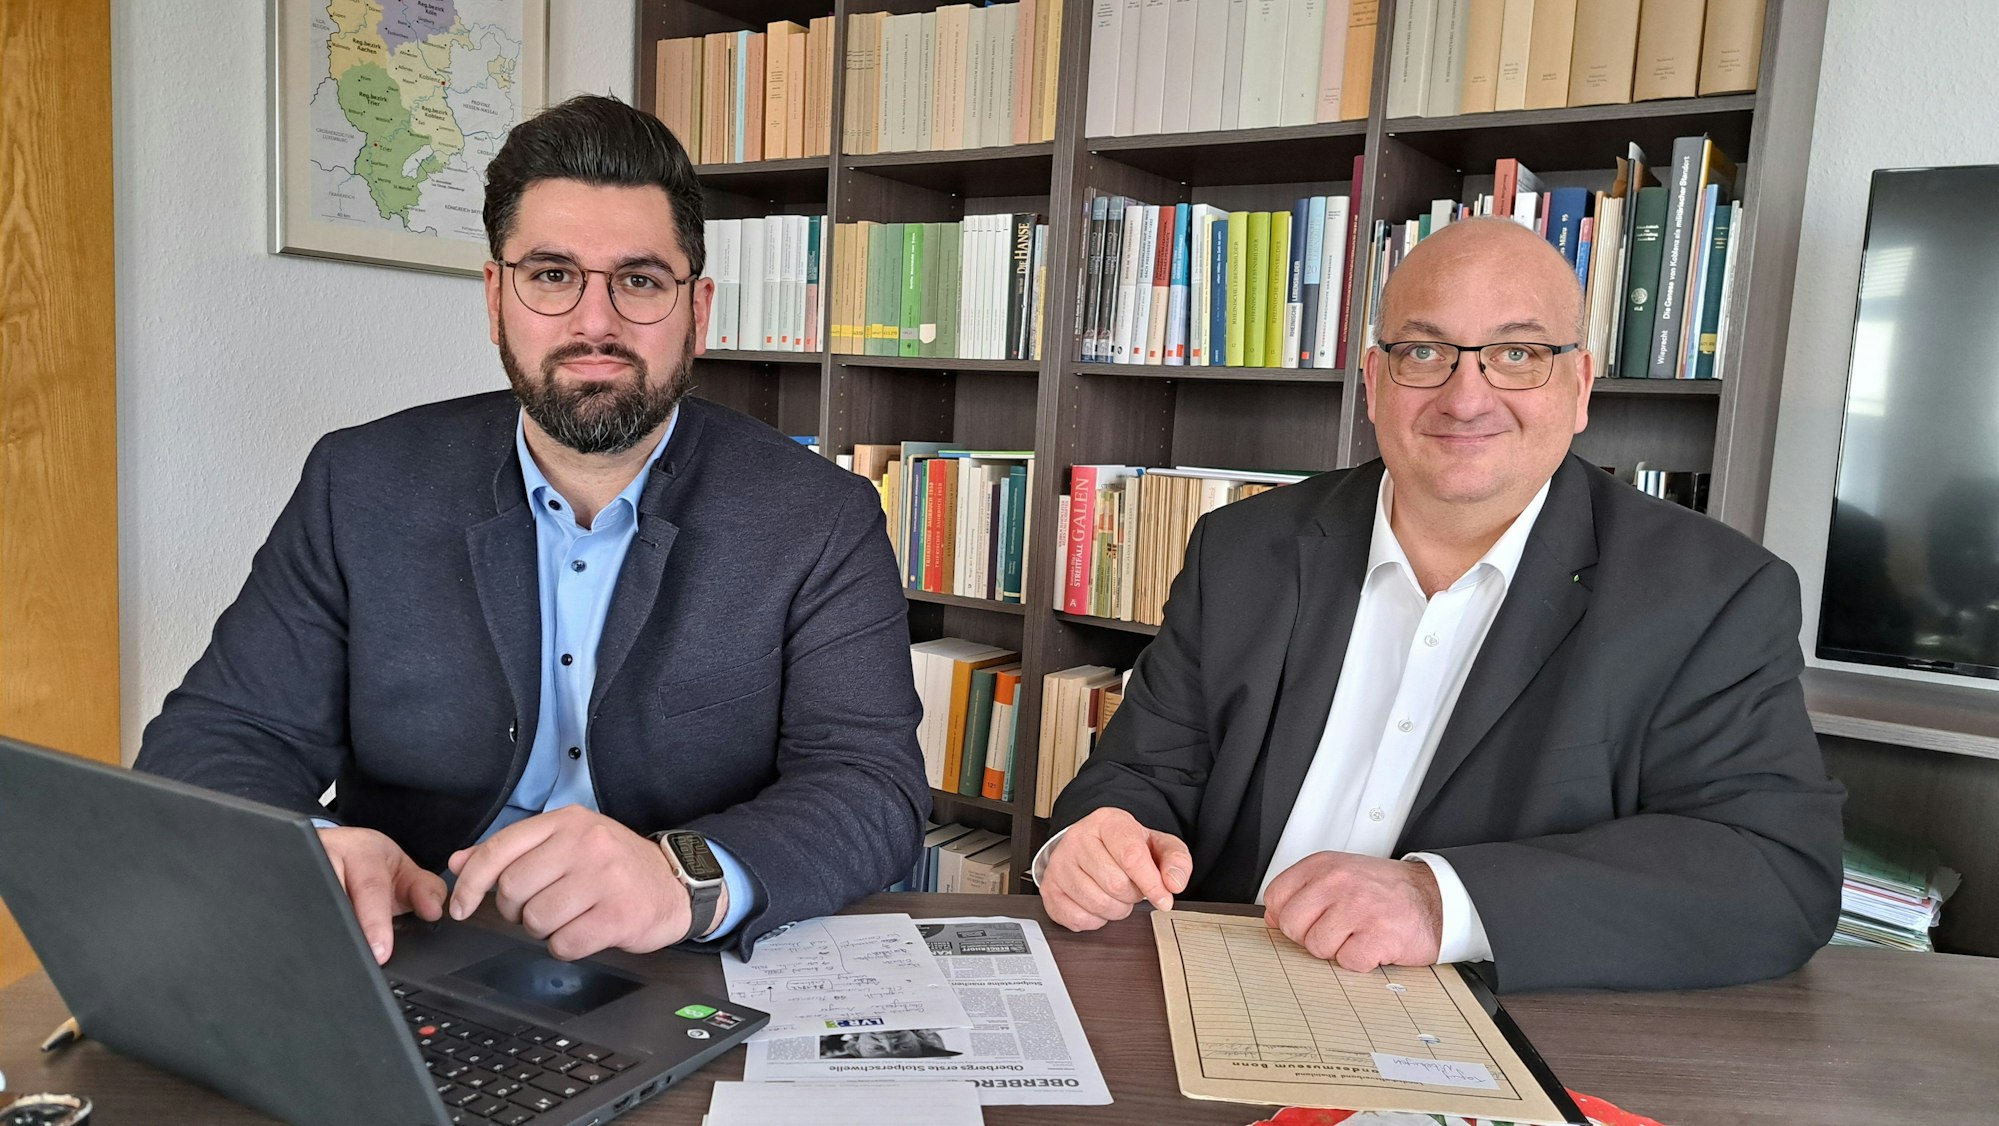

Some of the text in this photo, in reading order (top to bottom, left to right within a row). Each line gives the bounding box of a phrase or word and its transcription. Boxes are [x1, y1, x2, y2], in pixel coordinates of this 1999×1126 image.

[353, 37, 381, 49] Reg.bezirk
[419, 73, 441, 82] Koblenz
[359, 91, 387, 102] Reg.bezirk
[367, 99, 380, 107] Trier
[1014, 223, 1029, 274] DIE HANSE
[1669, 240, 1681, 267] Koblenz
[1273, 240, 1281, 284] LEBENSBILDER
[1668, 267, 1677, 280] von
[1289, 260, 1300, 337] RHEINISCHE LEBENSBILDER
[1072, 477, 1089, 542] GALEN
[1074, 543, 1083, 587] STREITFALL
[829, 1063, 925, 1072] Stolperschwelle
[960, 1063, 1024, 1072] Oberbergs
[1231, 1061, 1379, 1075] andesmuseum Bonn
